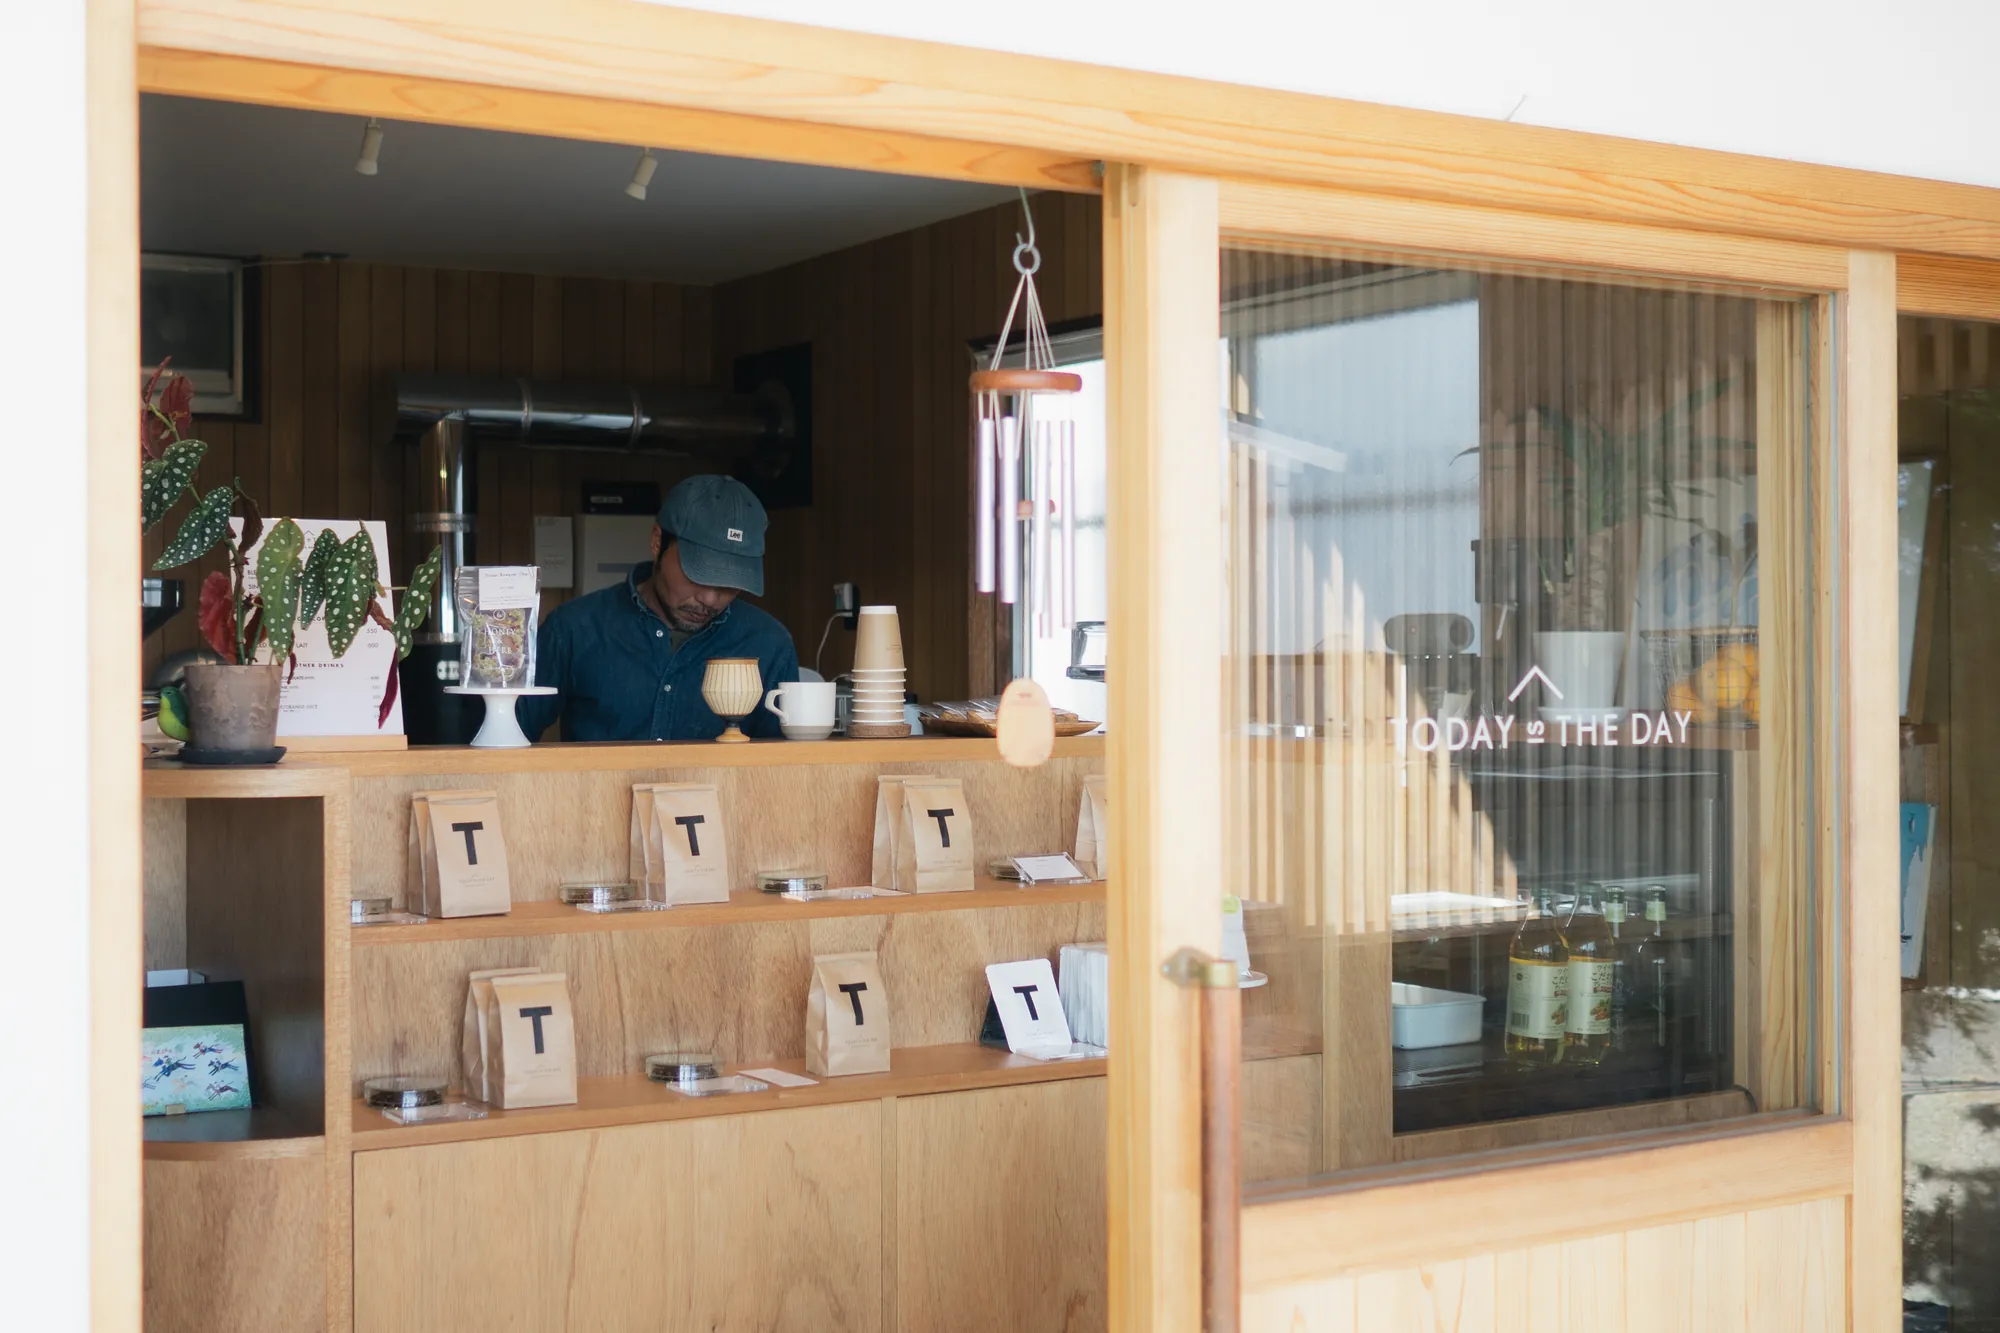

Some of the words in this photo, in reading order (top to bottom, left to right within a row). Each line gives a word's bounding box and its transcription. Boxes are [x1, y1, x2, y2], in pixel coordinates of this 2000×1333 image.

[730, 531, 740, 539] Lee
[1390, 714, 1515, 751] TODAY
[1527, 720, 1544, 744] IS
[1556, 713, 1619, 747] THE
[1631, 711, 1692, 745] DAY
[452, 821, 484, 865] T
[675, 815, 706, 856] T
[927, 808, 954, 848] T
[838, 982, 868, 1026] T
[1013, 985, 1038, 1021] T
[519, 1006, 553, 1054] T
